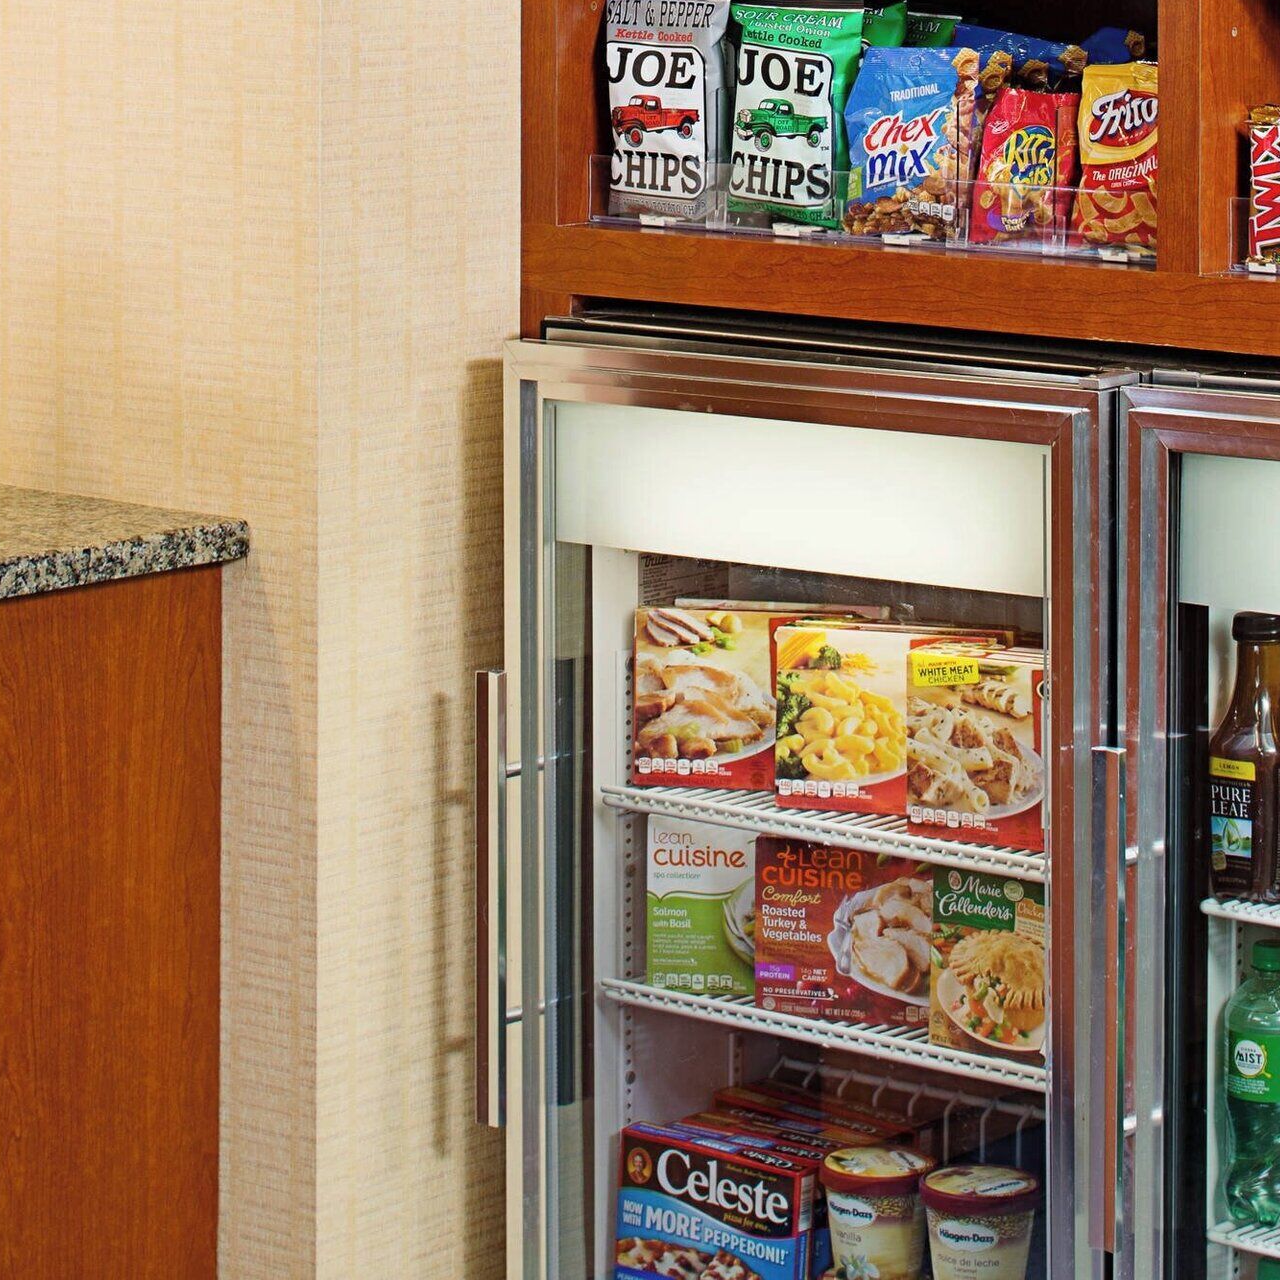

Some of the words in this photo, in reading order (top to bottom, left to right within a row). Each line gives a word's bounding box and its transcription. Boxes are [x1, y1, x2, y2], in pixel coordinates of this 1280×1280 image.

[607, 0, 639, 27] SALT
[645, 5, 655, 27] &
[660, 0, 715, 28] PEPPER
[735, 9, 775, 21] SOUR
[783, 13, 843, 29] CREAM
[614, 28, 654, 41] Kettle
[657, 31, 693, 43] Cooked
[796, 24, 832, 38] Onion
[778, 34, 822, 49] Cooked
[608, 47, 697, 90] JOE
[738, 48, 825, 97] JOE
[889, 83, 941, 103] TRADITIONAL
[1089, 88, 1158, 143] Frito
[864, 110, 943, 152] Chex
[867, 140, 930, 185] mix
[1092, 170, 1107, 182] The
[1108, 157, 1158, 181] ORIGINAL
[611, 150, 701, 195] CHIPS
[730, 150, 831, 200] CHIPS
[918, 666, 948, 677] WHITE
[950, 664, 974, 675] MEAT
[928, 675, 965, 684] CHICKEN
[1211, 784, 1252, 804] PURE
[1211, 801, 1249, 819] LEAF
[653, 827, 695, 846] lean
[653, 846, 746, 868] cuisine
[761, 886, 821, 905] Comfort
[952, 875, 1002, 902] Marie
[652, 906, 687, 918] Salmon
[761, 904, 806, 918] Roasted
[935, 890, 1013, 920] Callender's
[669, 918, 692, 929] Basil
[762, 916, 797, 931] Turkey
[799, 920, 808, 930] &
[762, 928, 822, 943] Vegetables
[759, 970, 791, 980] PROTEIN
[762, 986, 772, 994] NO
[774, 987, 826, 998] PRESERVATIVES
[1235, 1052, 1263, 1065] MIST
[657, 1149, 789, 1225] Celeste
[623, 1199, 644, 1215] NOW
[623, 1213, 642, 1227] WITH
[646, 1205, 701, 1241] MORE
[974, 1257, 1000, 1268] leche
